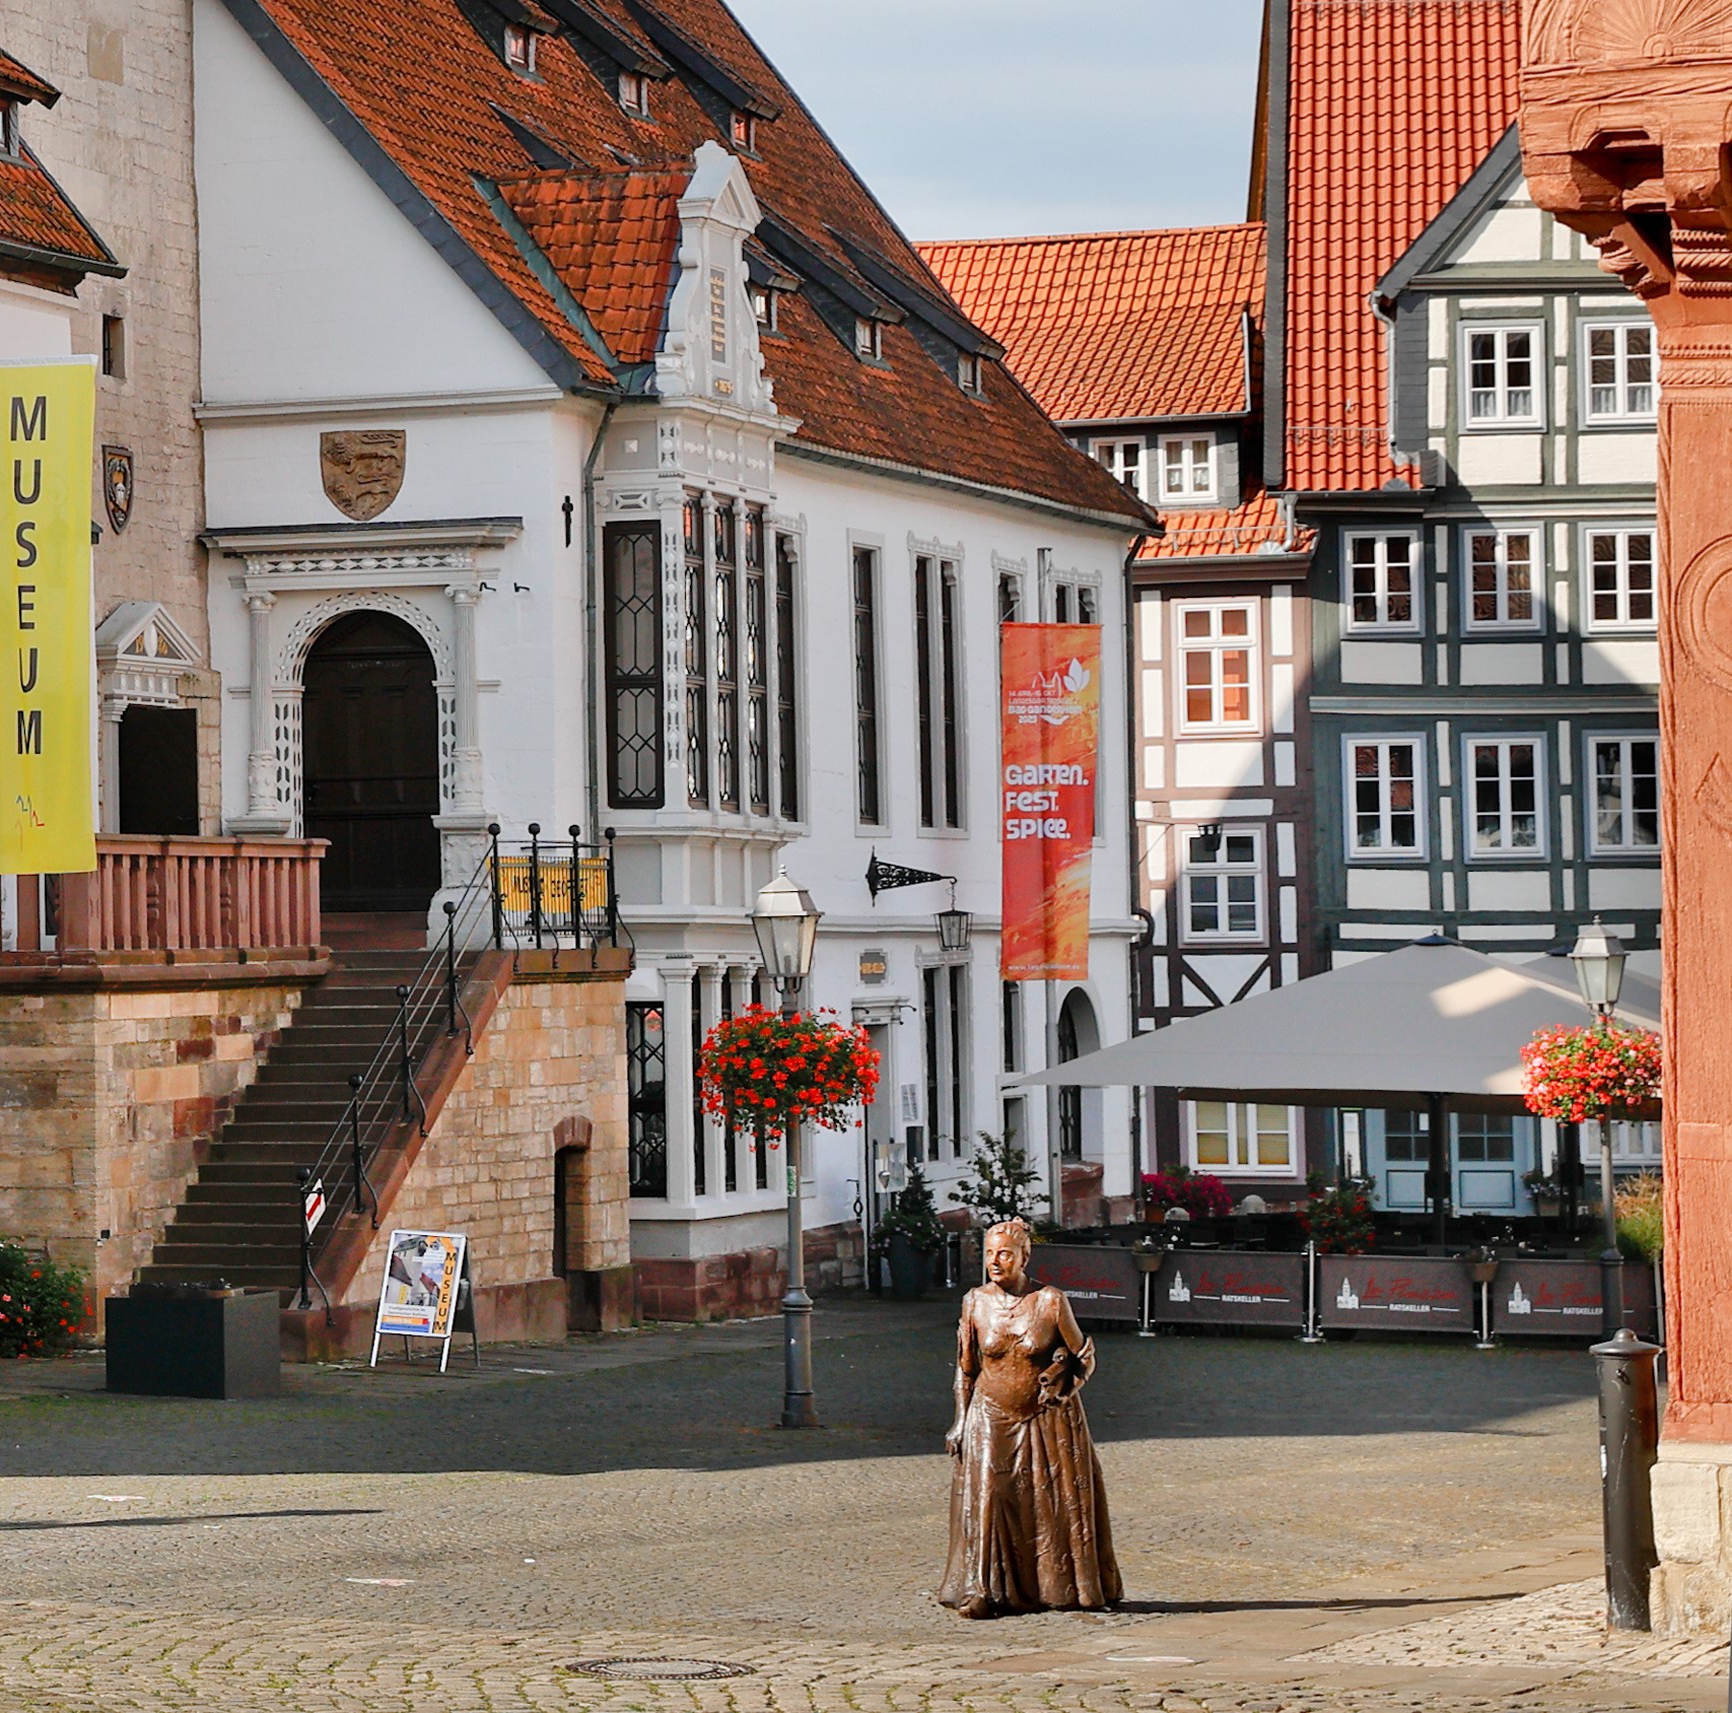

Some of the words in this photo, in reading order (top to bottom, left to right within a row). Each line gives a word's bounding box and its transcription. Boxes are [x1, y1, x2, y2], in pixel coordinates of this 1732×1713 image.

[10, 395, 47, 755] MUSEUM
[434, 1252, 457, 1330] MUSEUM
[1221, 1294, 1262, 1303] RATSKELLER
[1389, 1303, 1431, 1312] RATSKELLER
